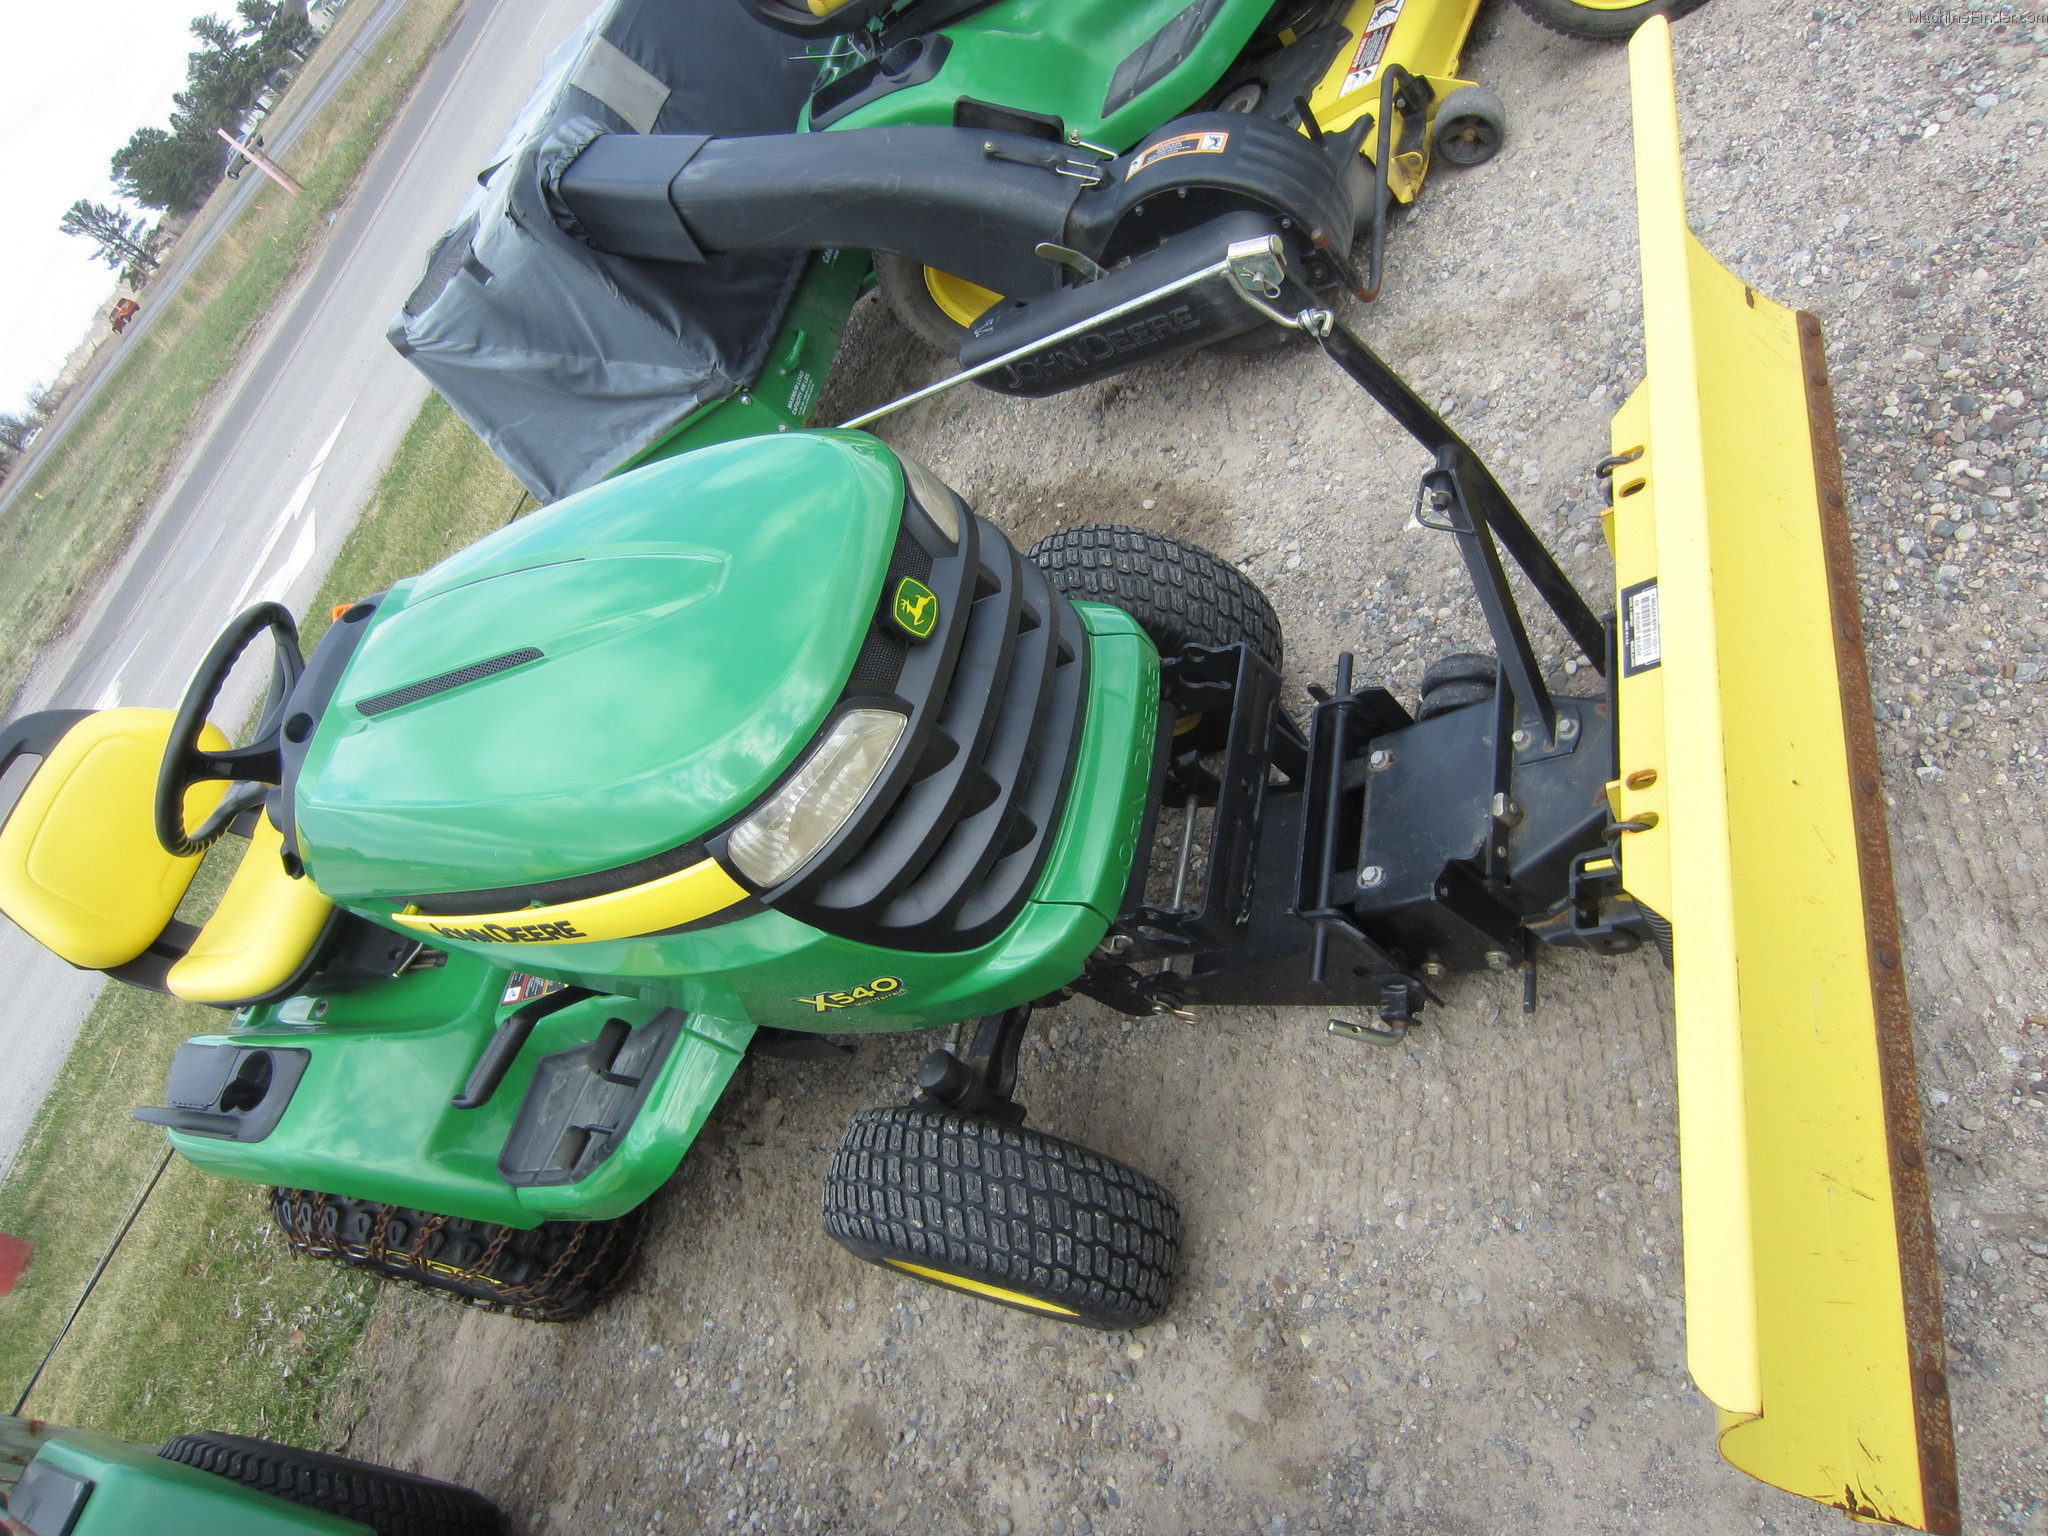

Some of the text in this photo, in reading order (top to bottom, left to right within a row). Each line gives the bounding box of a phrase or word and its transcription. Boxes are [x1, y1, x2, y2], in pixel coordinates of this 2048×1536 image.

[1004, 304, 1200, 389] JOHN DEERE
[787, 370, 804, 409] MAXIMUM LOAD
[791, 390, 803, 415] CAPACITY
[483, 920, 587, 943] DEERE
[792, 975, 901, 1013] X540
